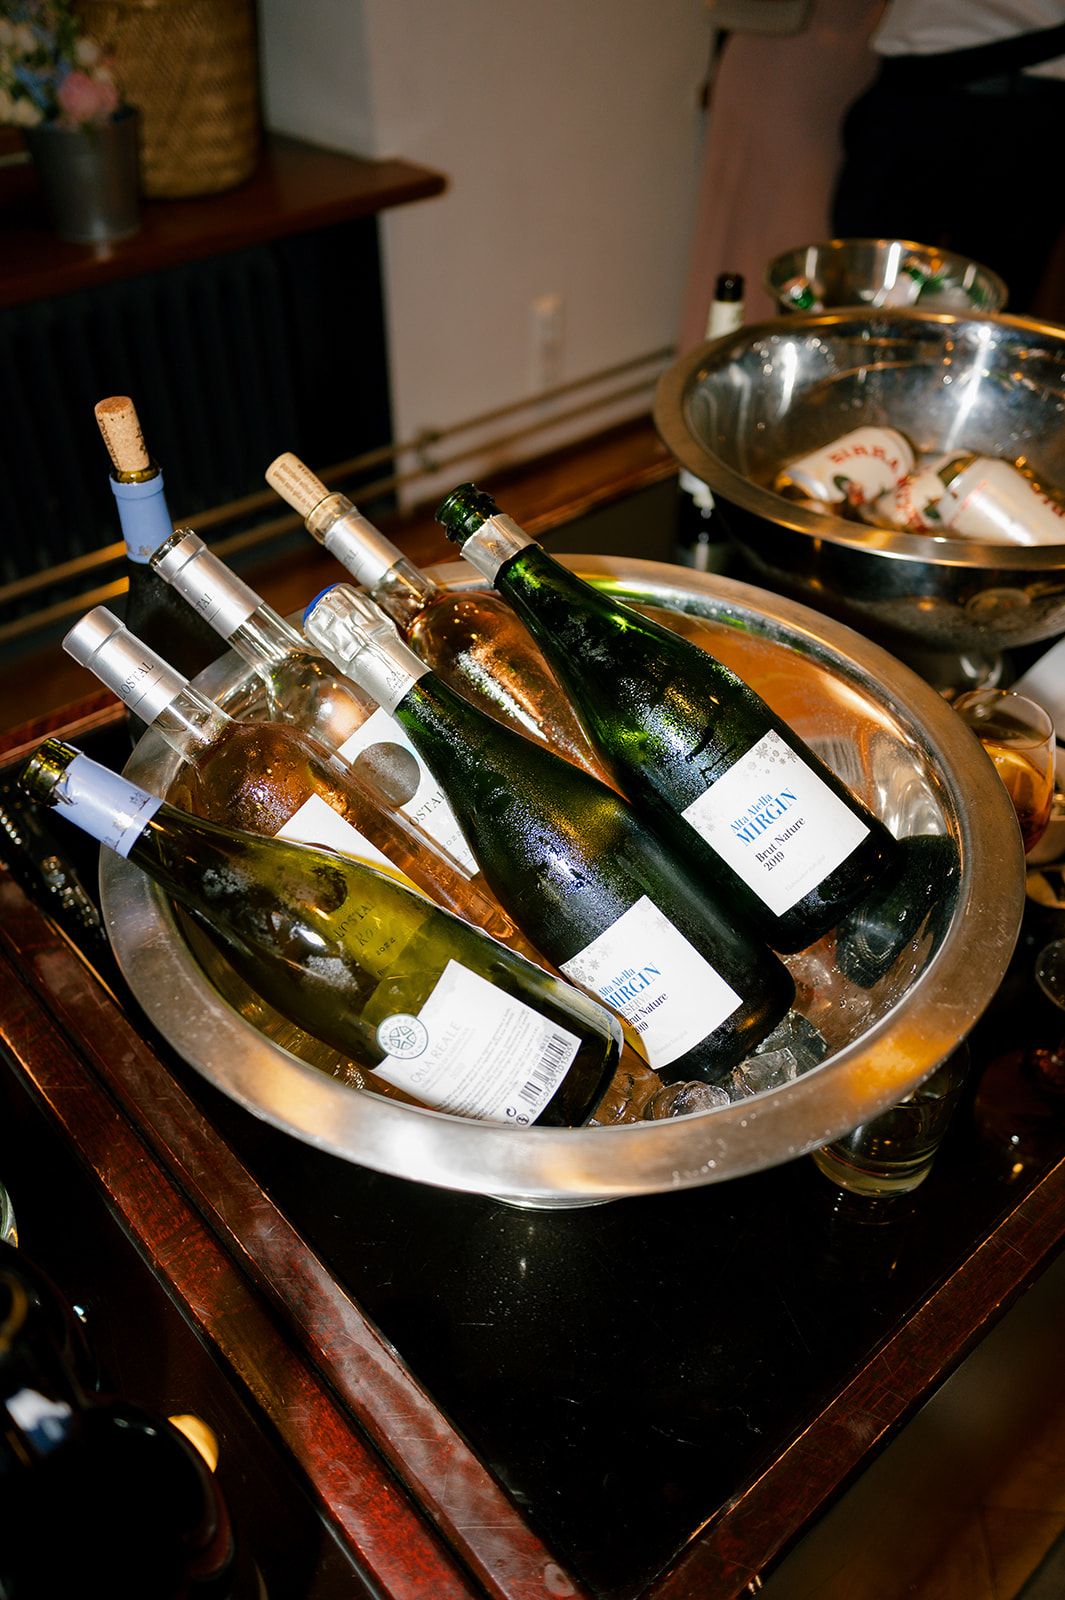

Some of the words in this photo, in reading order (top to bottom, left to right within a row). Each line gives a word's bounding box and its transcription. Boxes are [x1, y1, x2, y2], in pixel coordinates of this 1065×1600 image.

[730, 814, 750, 833] Alta
[747, 793, 773, 817] Alella
[736, 787, 798, 847] MIRGIN
[755, 843, 778, 863] Brut
[774, 817, 806, 846] Nature
[763, 851, 785, 871] 2019
[638, 992, 669, 1018] Nature
[430, 1021, 462, 1060] REALE
